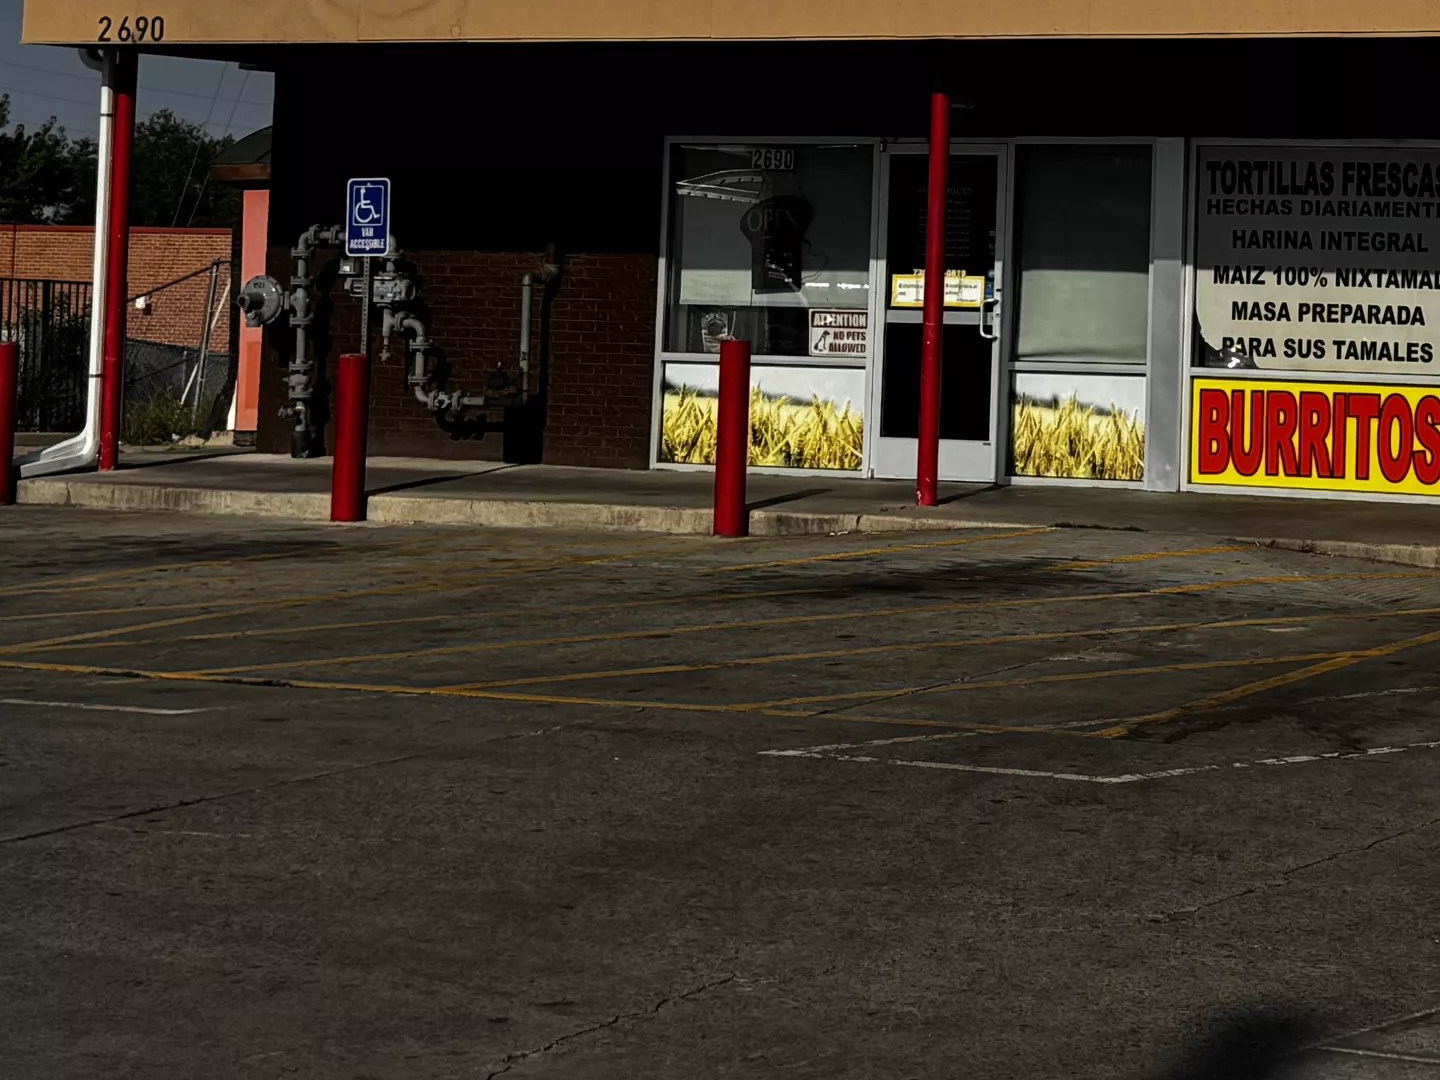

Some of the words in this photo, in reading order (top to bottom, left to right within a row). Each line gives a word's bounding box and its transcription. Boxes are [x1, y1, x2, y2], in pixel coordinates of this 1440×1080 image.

[97, 15, 165, 43] 2690
[753, 150, 793, 169] 2690
[1206, 161, 1334, 194] TORTILLAS
[1206, 198, 1293, 214] HECHAS
[350, 238, 386, 250] ACCESSIBLE
[1232, 229, 1313, 248] HARINA
[1320, 232, 1429, 251] INTEGRAL
[1213, 264, 1266, 284] MAIZ
[1272, 266, 1328, 286] 100%
[813, 311, 866, 328] ATTENTION
[1231, 300, 1291, 320] MASA
[1297, 302, 1426, 324] PREPARADA
[833, 331, 845, 341] NO
[846, 331, 867, 342] PETS
[829, 342, 867, 354] ALLOWED
[1222, 336, 1277, 356] PARA
[1283, 337, 1326, 359] SUS
[1333, 339, 1434, 361] TAMALES
